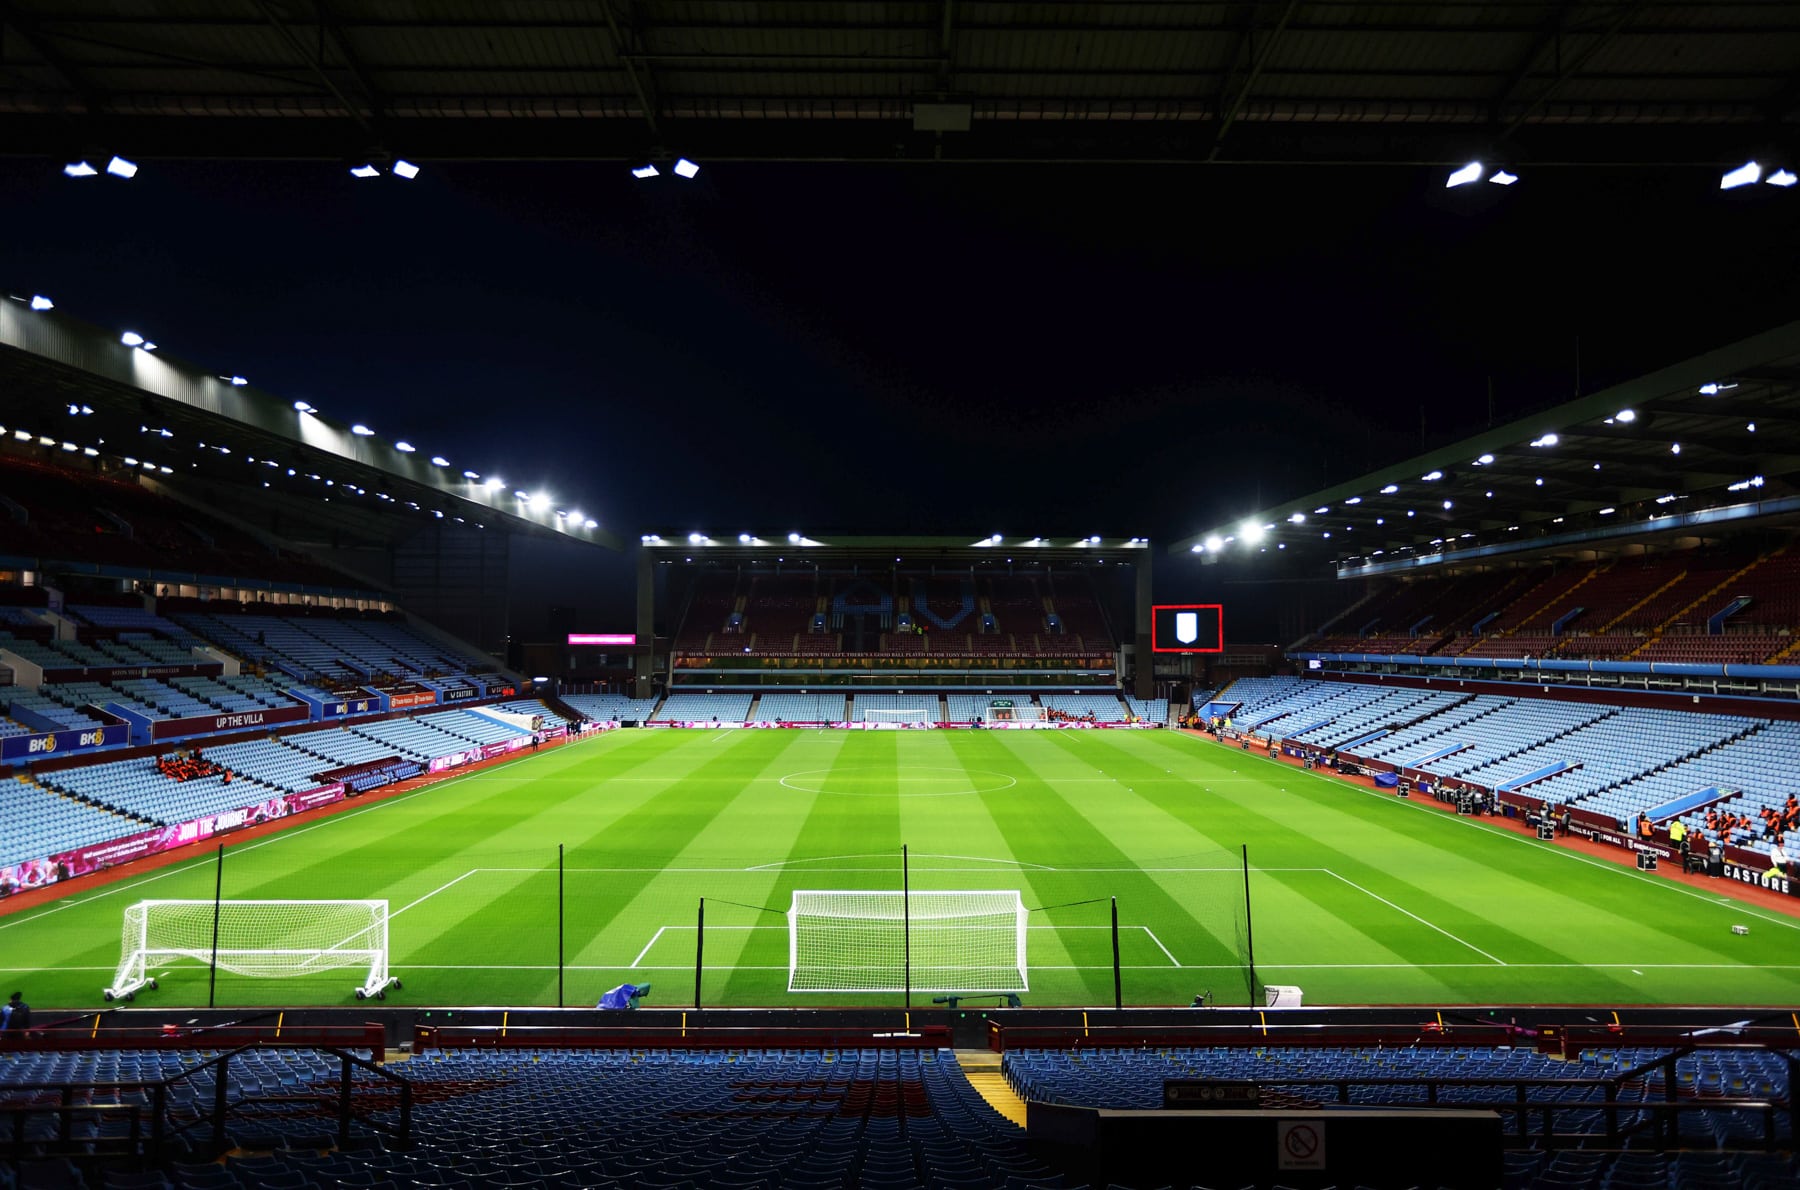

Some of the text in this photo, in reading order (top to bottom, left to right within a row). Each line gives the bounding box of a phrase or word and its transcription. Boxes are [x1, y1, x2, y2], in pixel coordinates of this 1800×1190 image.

[217, 713, 263, 728] UP THE VILLA
[29, 734, 57, 752] BK8
[80, 728, 104, 746] BK8
[178, 808, 248, 840] JOIN THE JOURNEY
[1724, 864, 1789, 894] CASTORE
